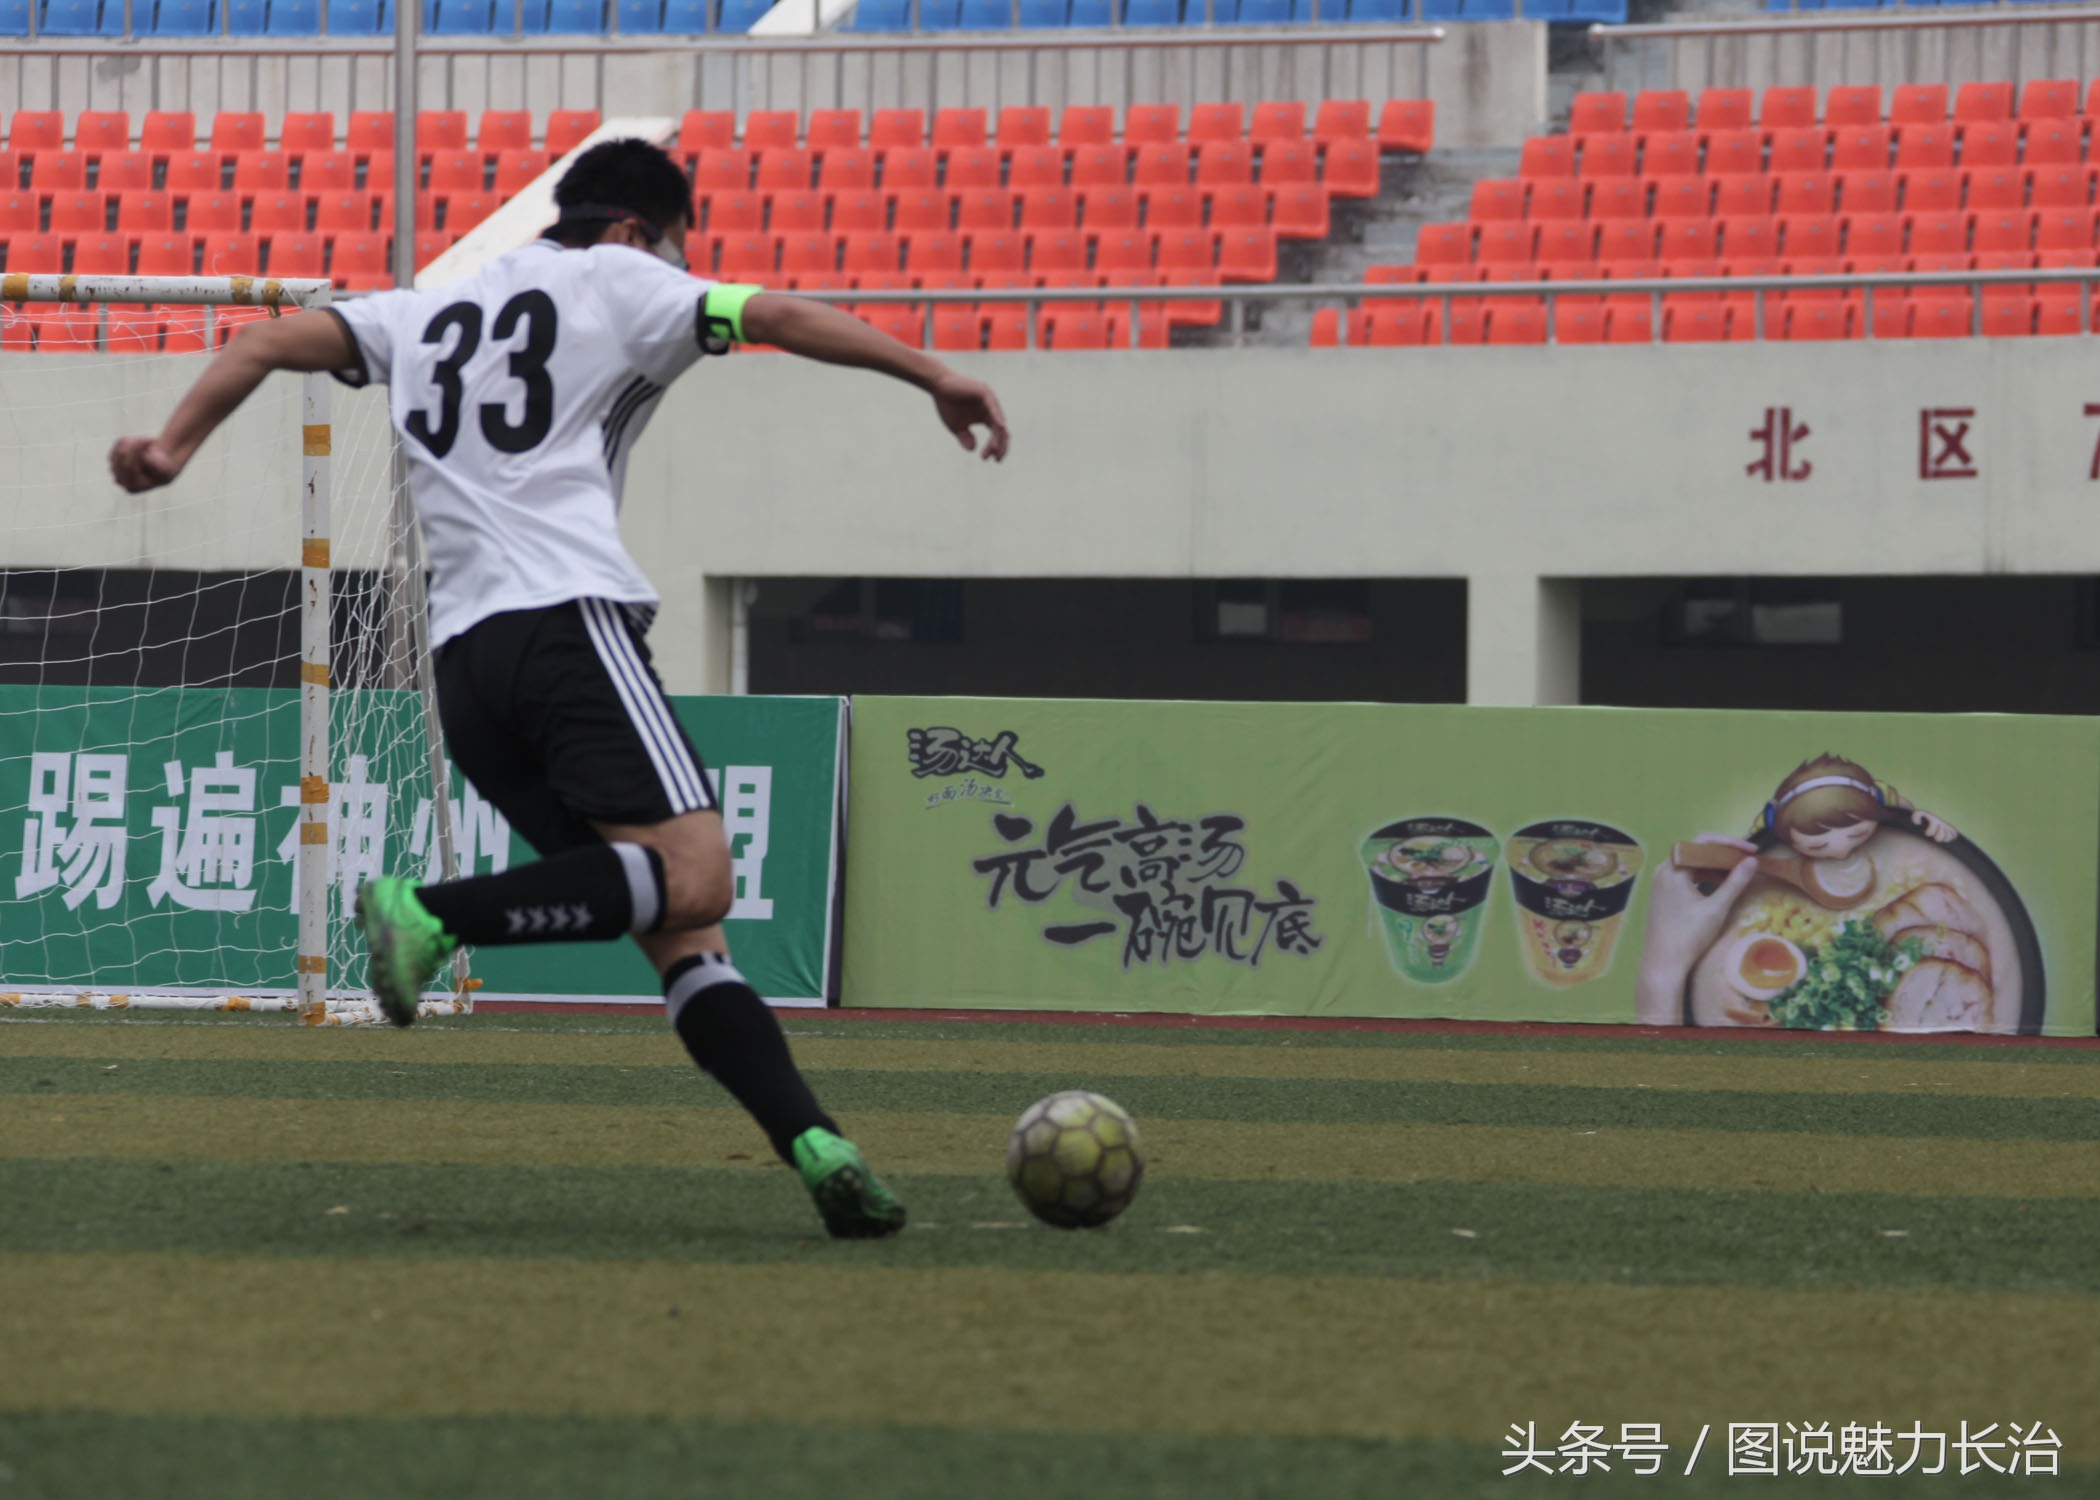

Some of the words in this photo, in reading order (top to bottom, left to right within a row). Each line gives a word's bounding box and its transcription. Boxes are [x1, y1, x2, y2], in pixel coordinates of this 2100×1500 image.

[405, 288, 558, 460] 33
[907, 727, 1045, 779] 汤达人
[15, 750, 774, 920] 踢遍神州盟
[973, 804, 1245, 908] 元气高汤
[1044, 880, 1323, 968] 一碗见底
